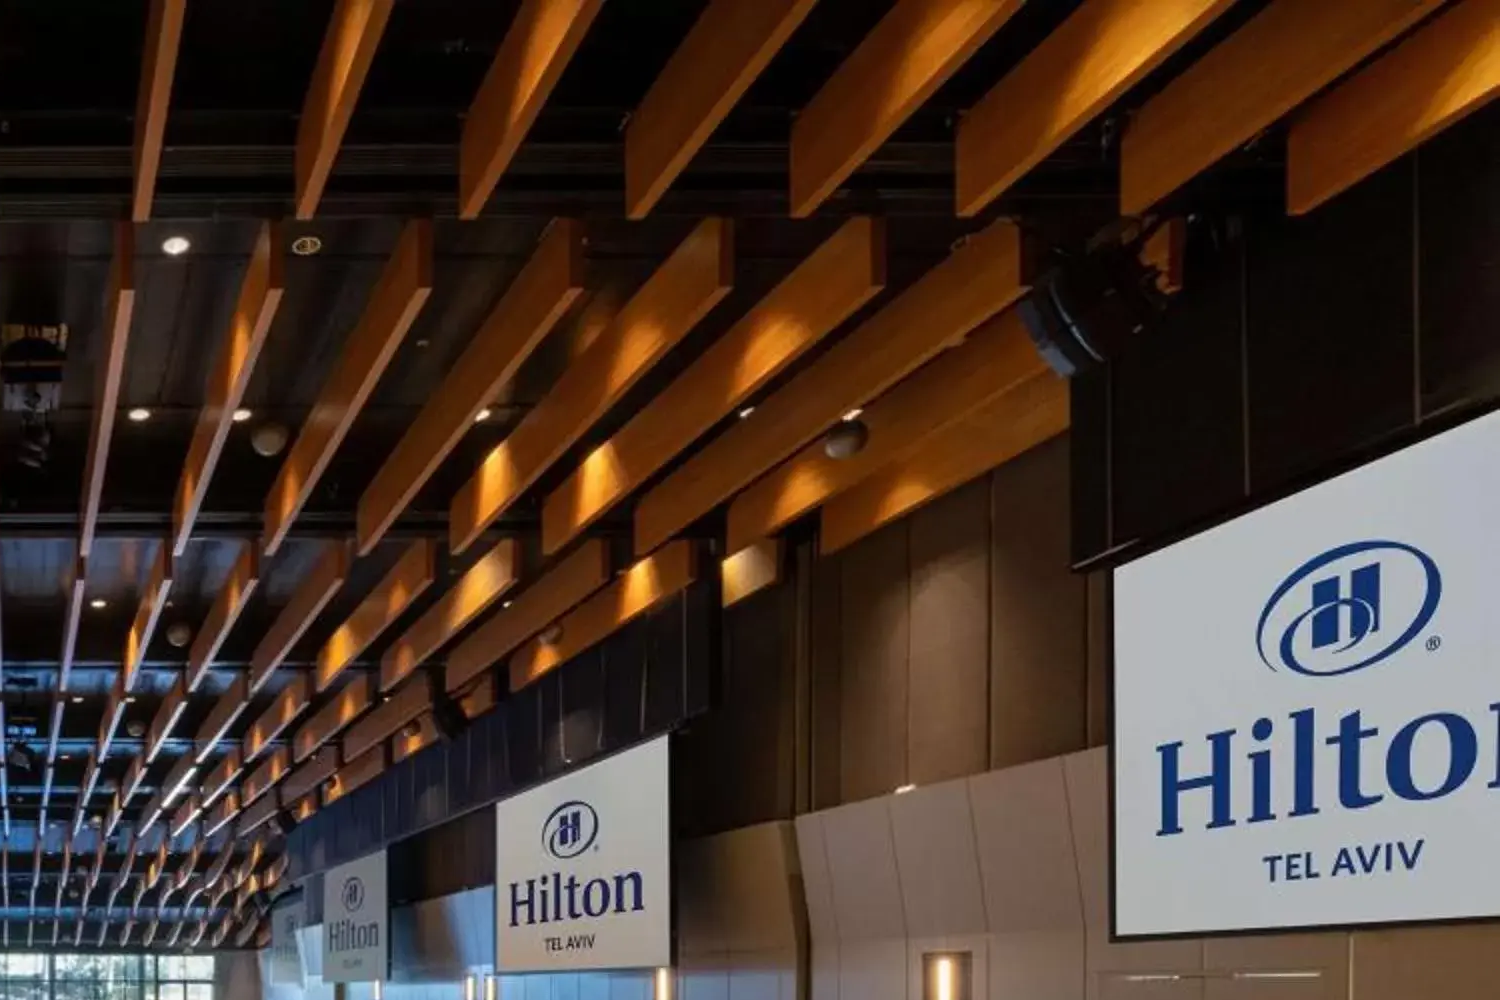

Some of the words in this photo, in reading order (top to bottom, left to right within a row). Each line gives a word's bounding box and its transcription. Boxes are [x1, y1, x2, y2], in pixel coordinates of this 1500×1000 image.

[1156, 702, 1500, 837] Hilto
[1262, 851, 1320, 882] TEL
[1331, 839, 1425, 876] AVIV
[509, 871, 645, 927] Hilton
[329, 918, 379, 953] Hilton
[545, 936, 563, 953] TEL
[565, 933, 596, 950] AVIV
